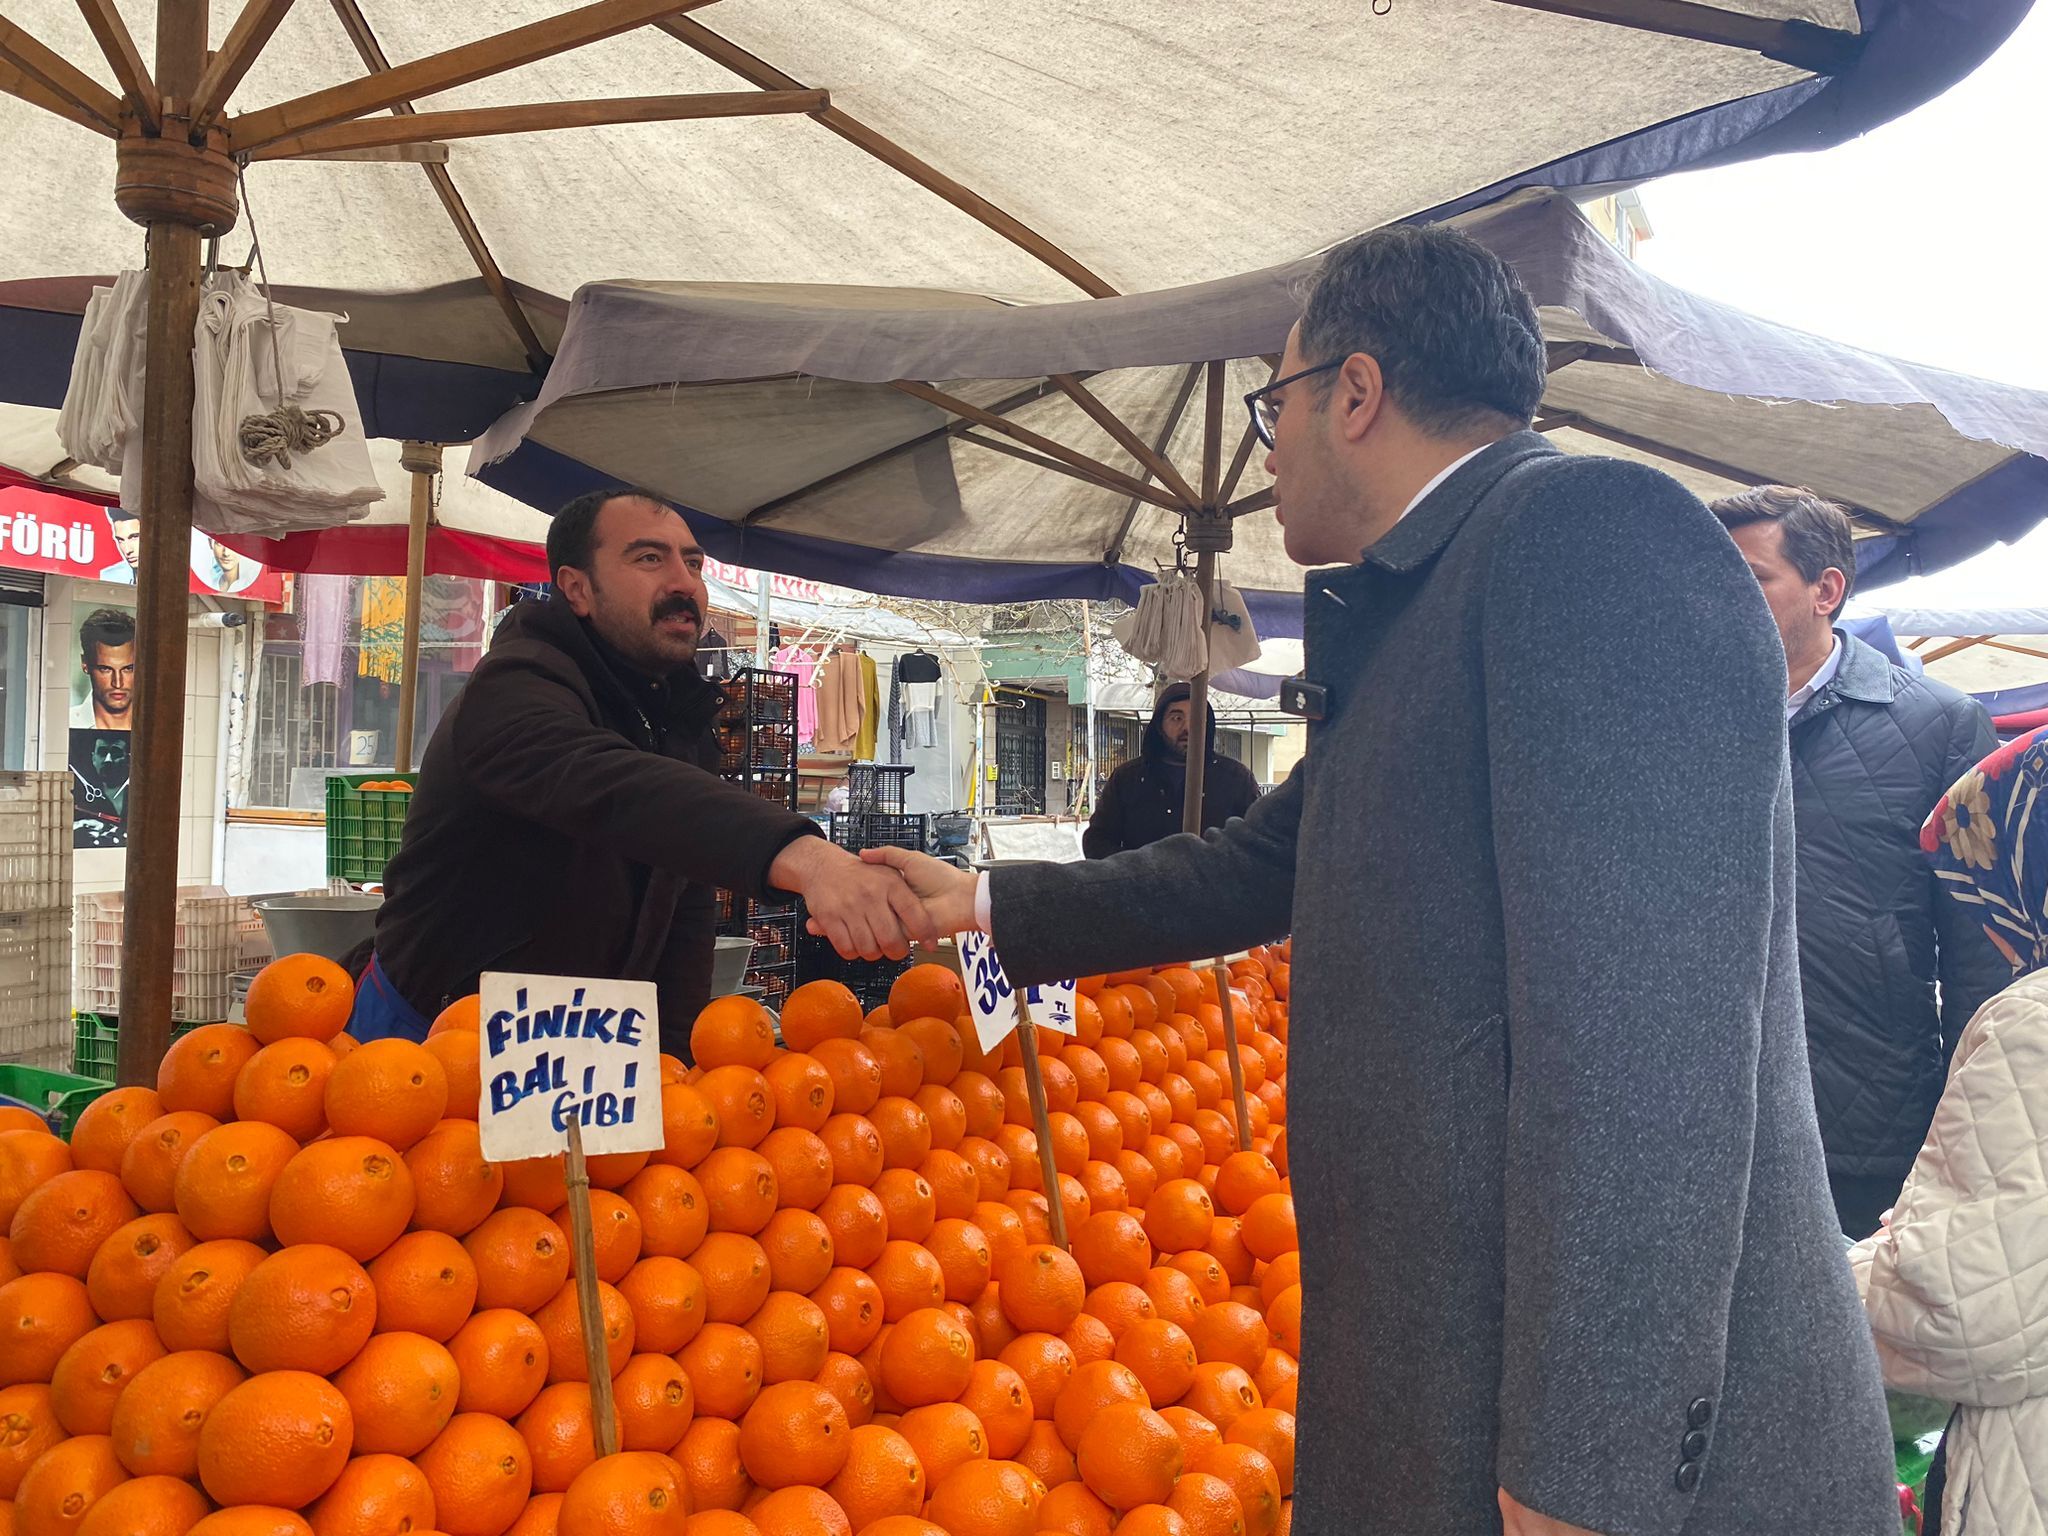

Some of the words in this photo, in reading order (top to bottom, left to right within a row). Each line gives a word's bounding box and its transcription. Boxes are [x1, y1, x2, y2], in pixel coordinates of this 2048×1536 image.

[356, 735, 374, 755] 25
[1055, 1000, 1068, 1013] TL
[490, 1052, 568, 1115] BAL
